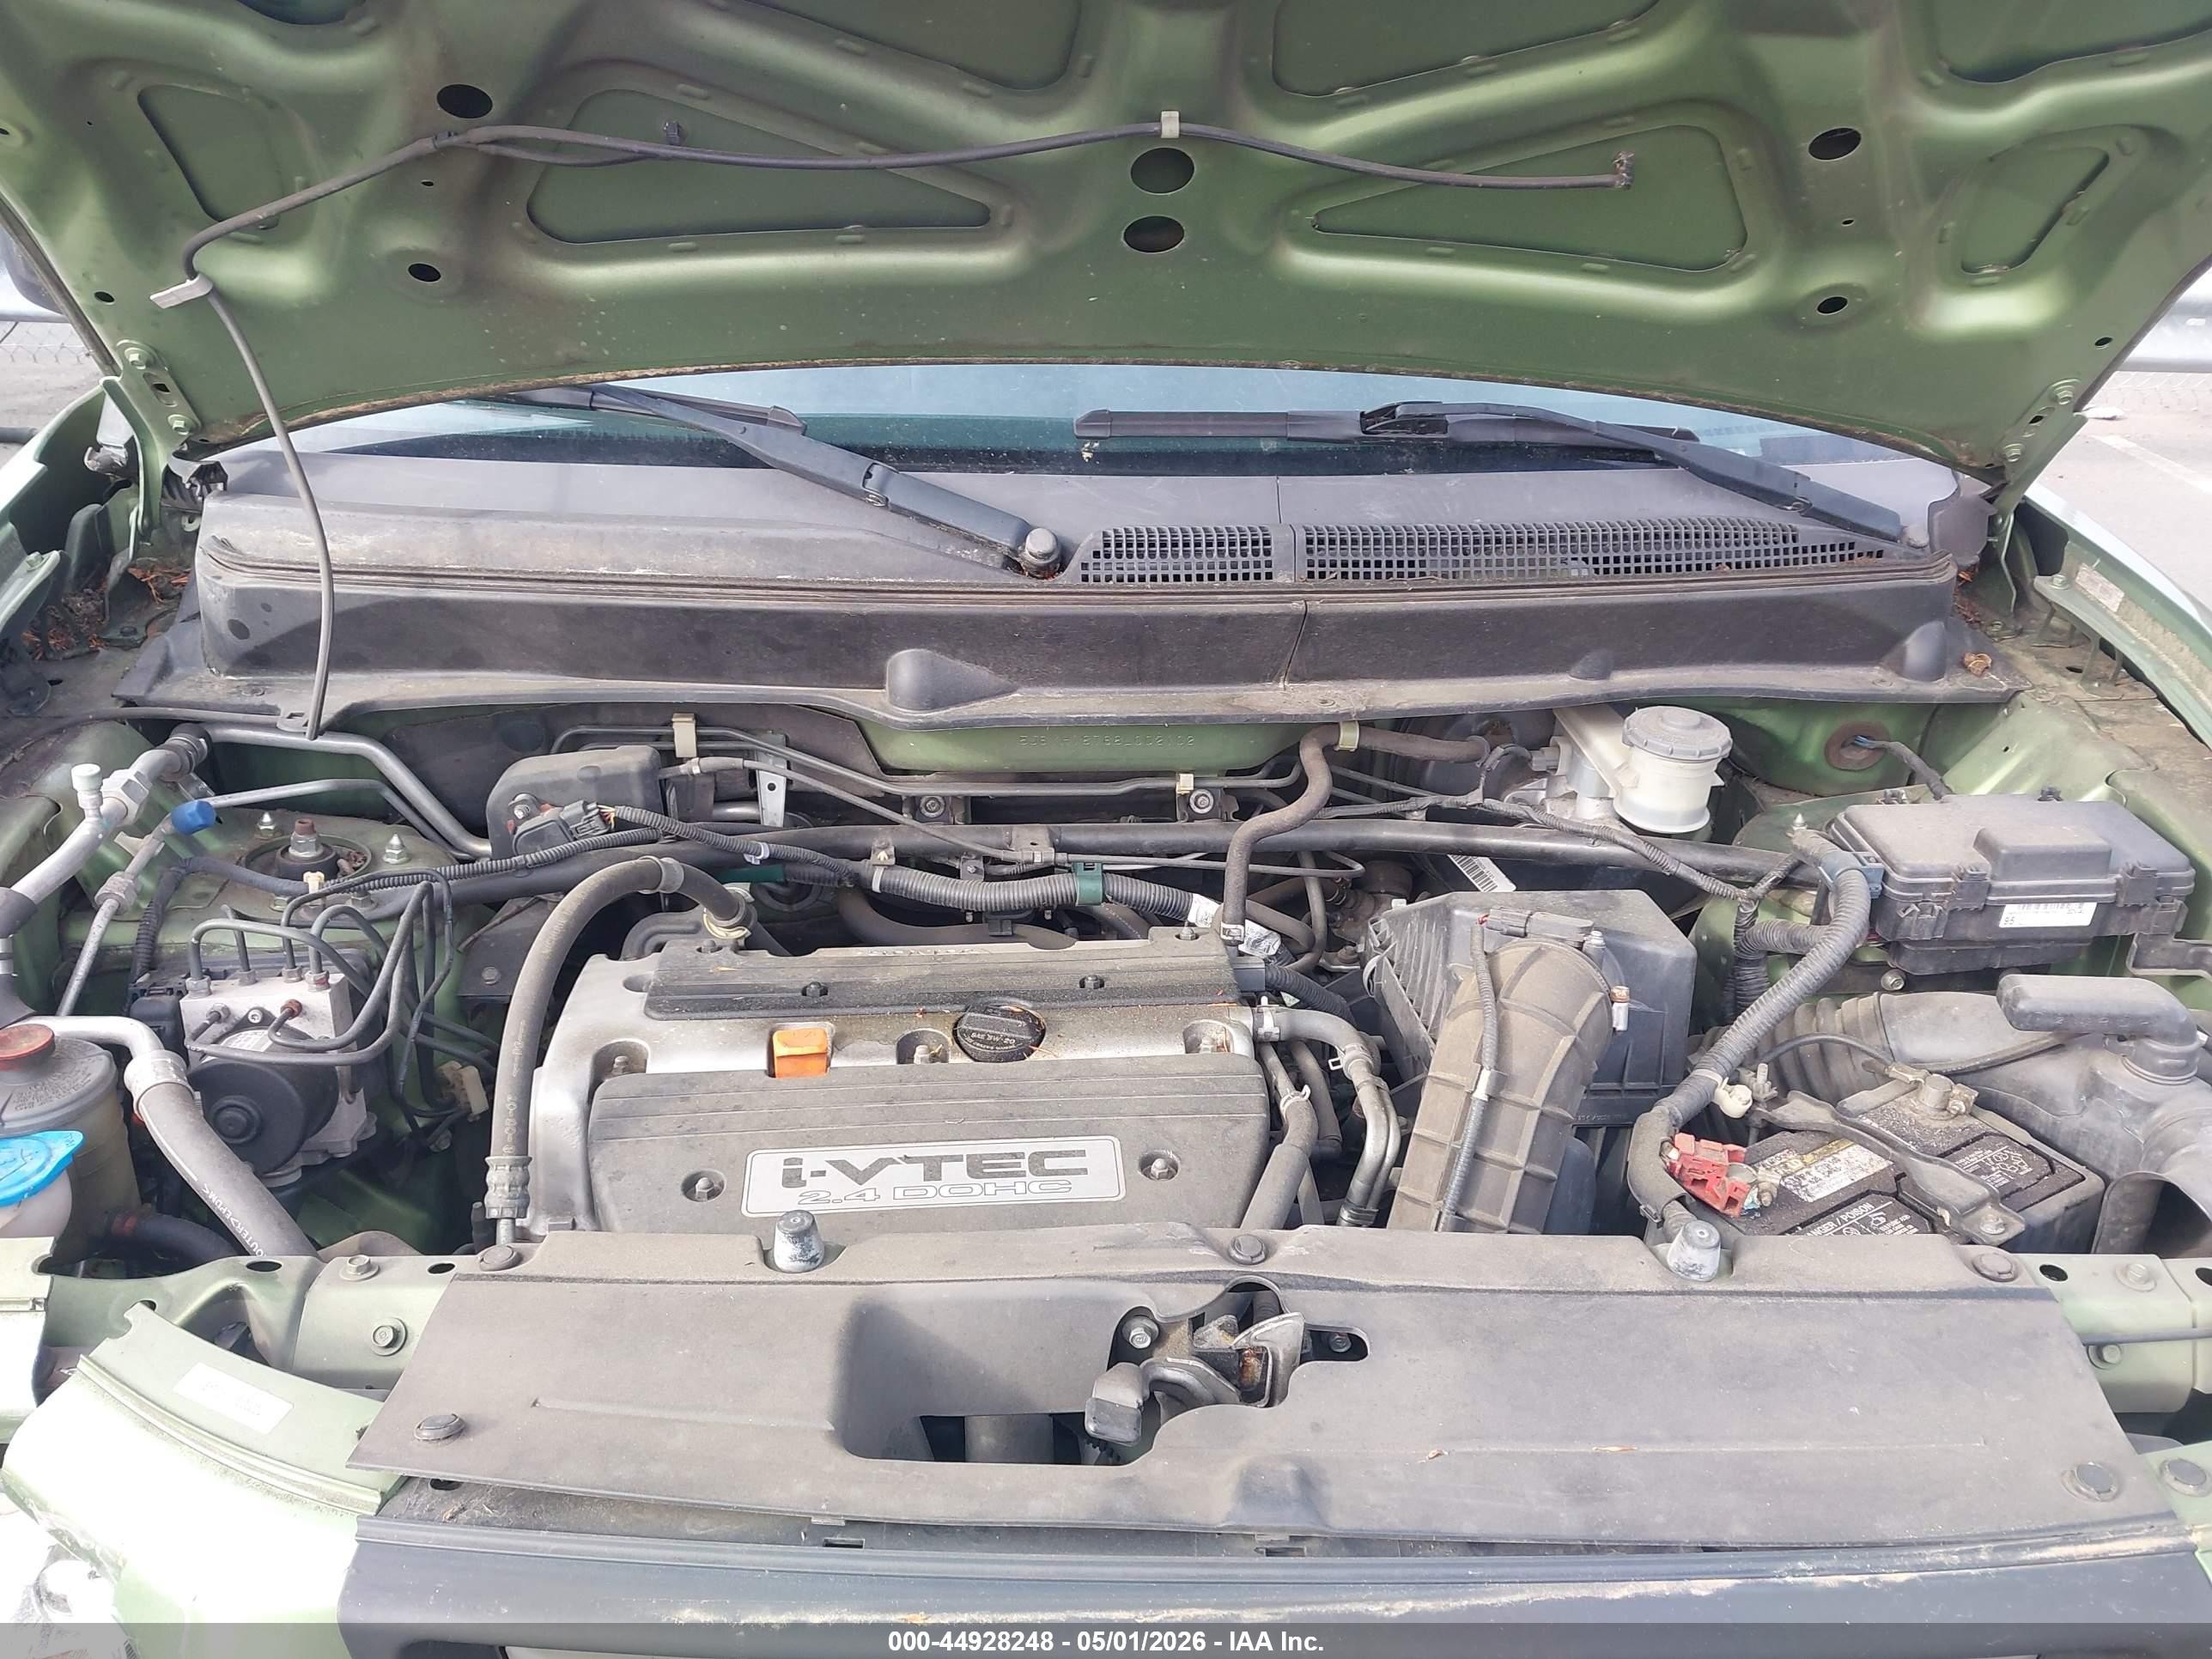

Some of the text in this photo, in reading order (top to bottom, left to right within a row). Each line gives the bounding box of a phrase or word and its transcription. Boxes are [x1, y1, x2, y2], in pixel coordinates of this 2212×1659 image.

[781, 1150, 1089, 1188] i-VTEC
[797, 1179, 1073, 1205] 2.4 DOHC
[1806, 1221, 1836, 1236] ANGER
[1840, 1202, 1875, 1222] POISON
